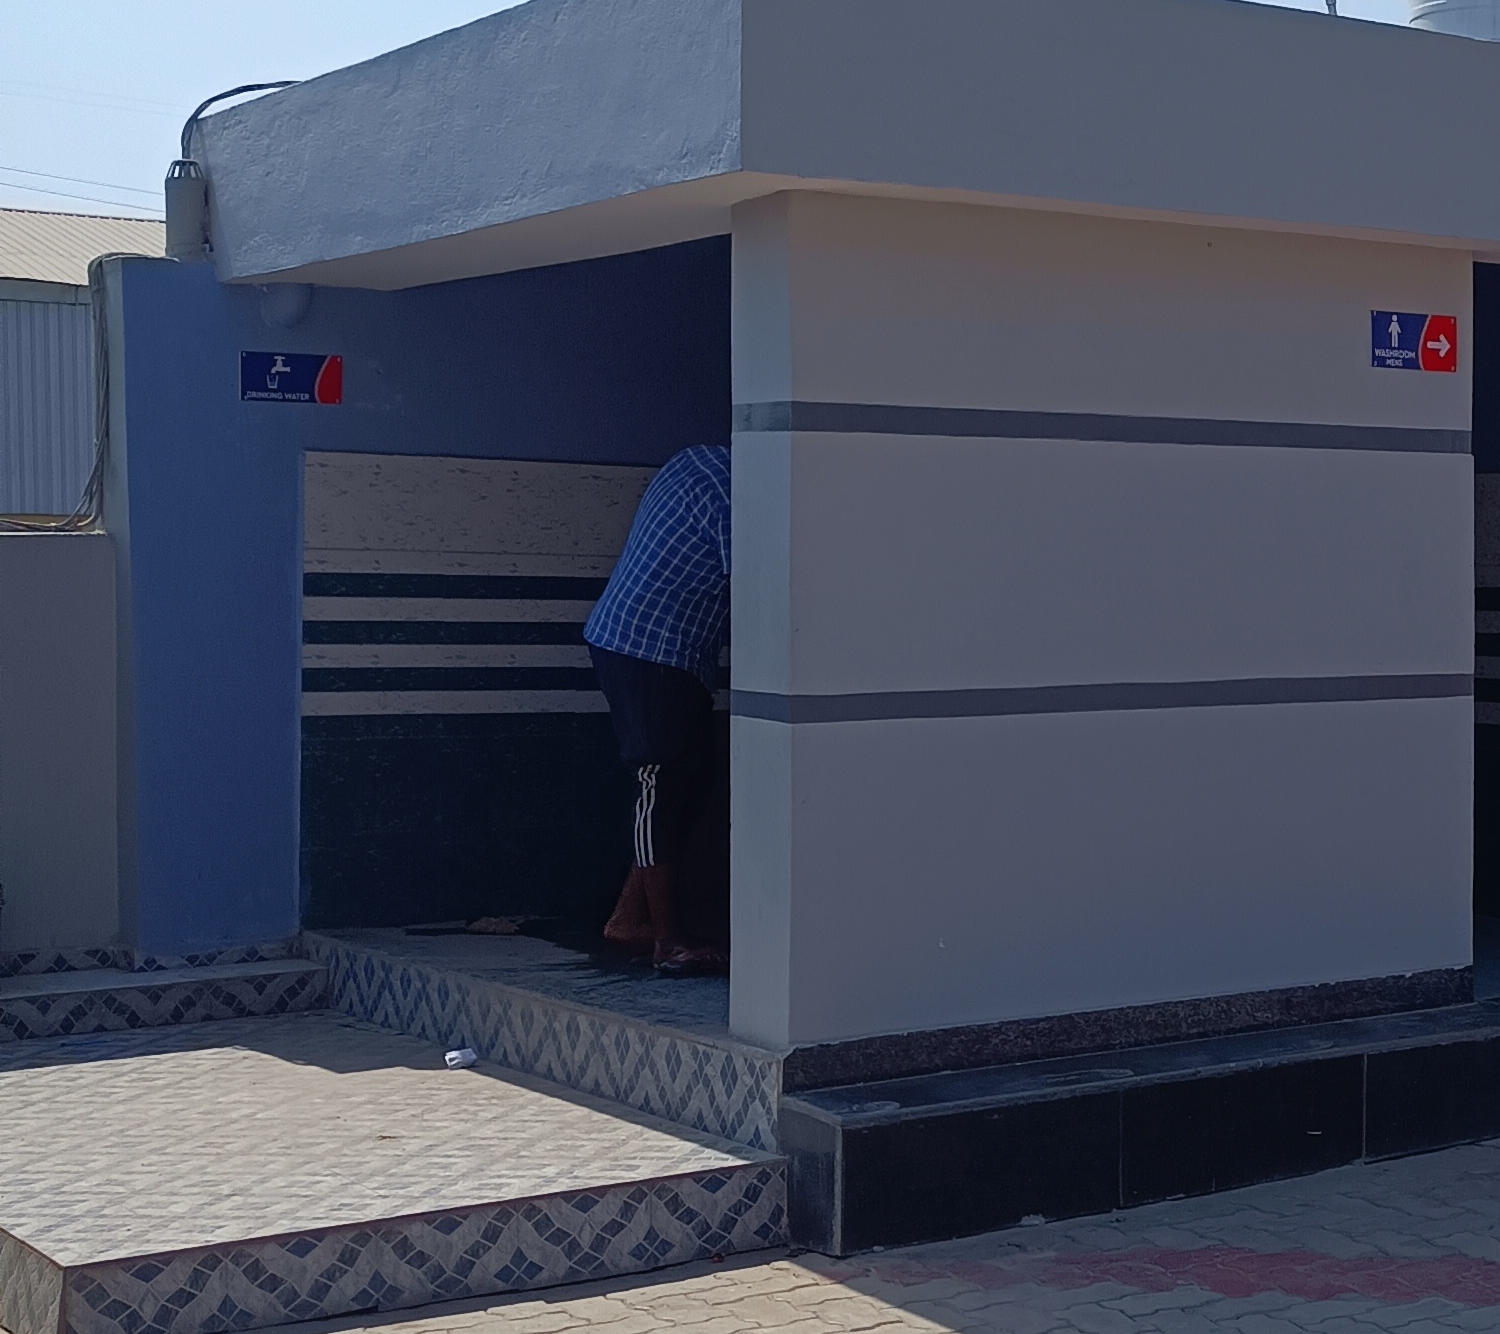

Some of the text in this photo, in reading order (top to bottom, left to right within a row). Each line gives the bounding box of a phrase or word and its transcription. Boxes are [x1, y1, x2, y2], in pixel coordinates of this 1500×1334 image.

[1374, 348, 1416, 359] WASHROOM
[246, 390, 310, 401] DRINKING WATER
